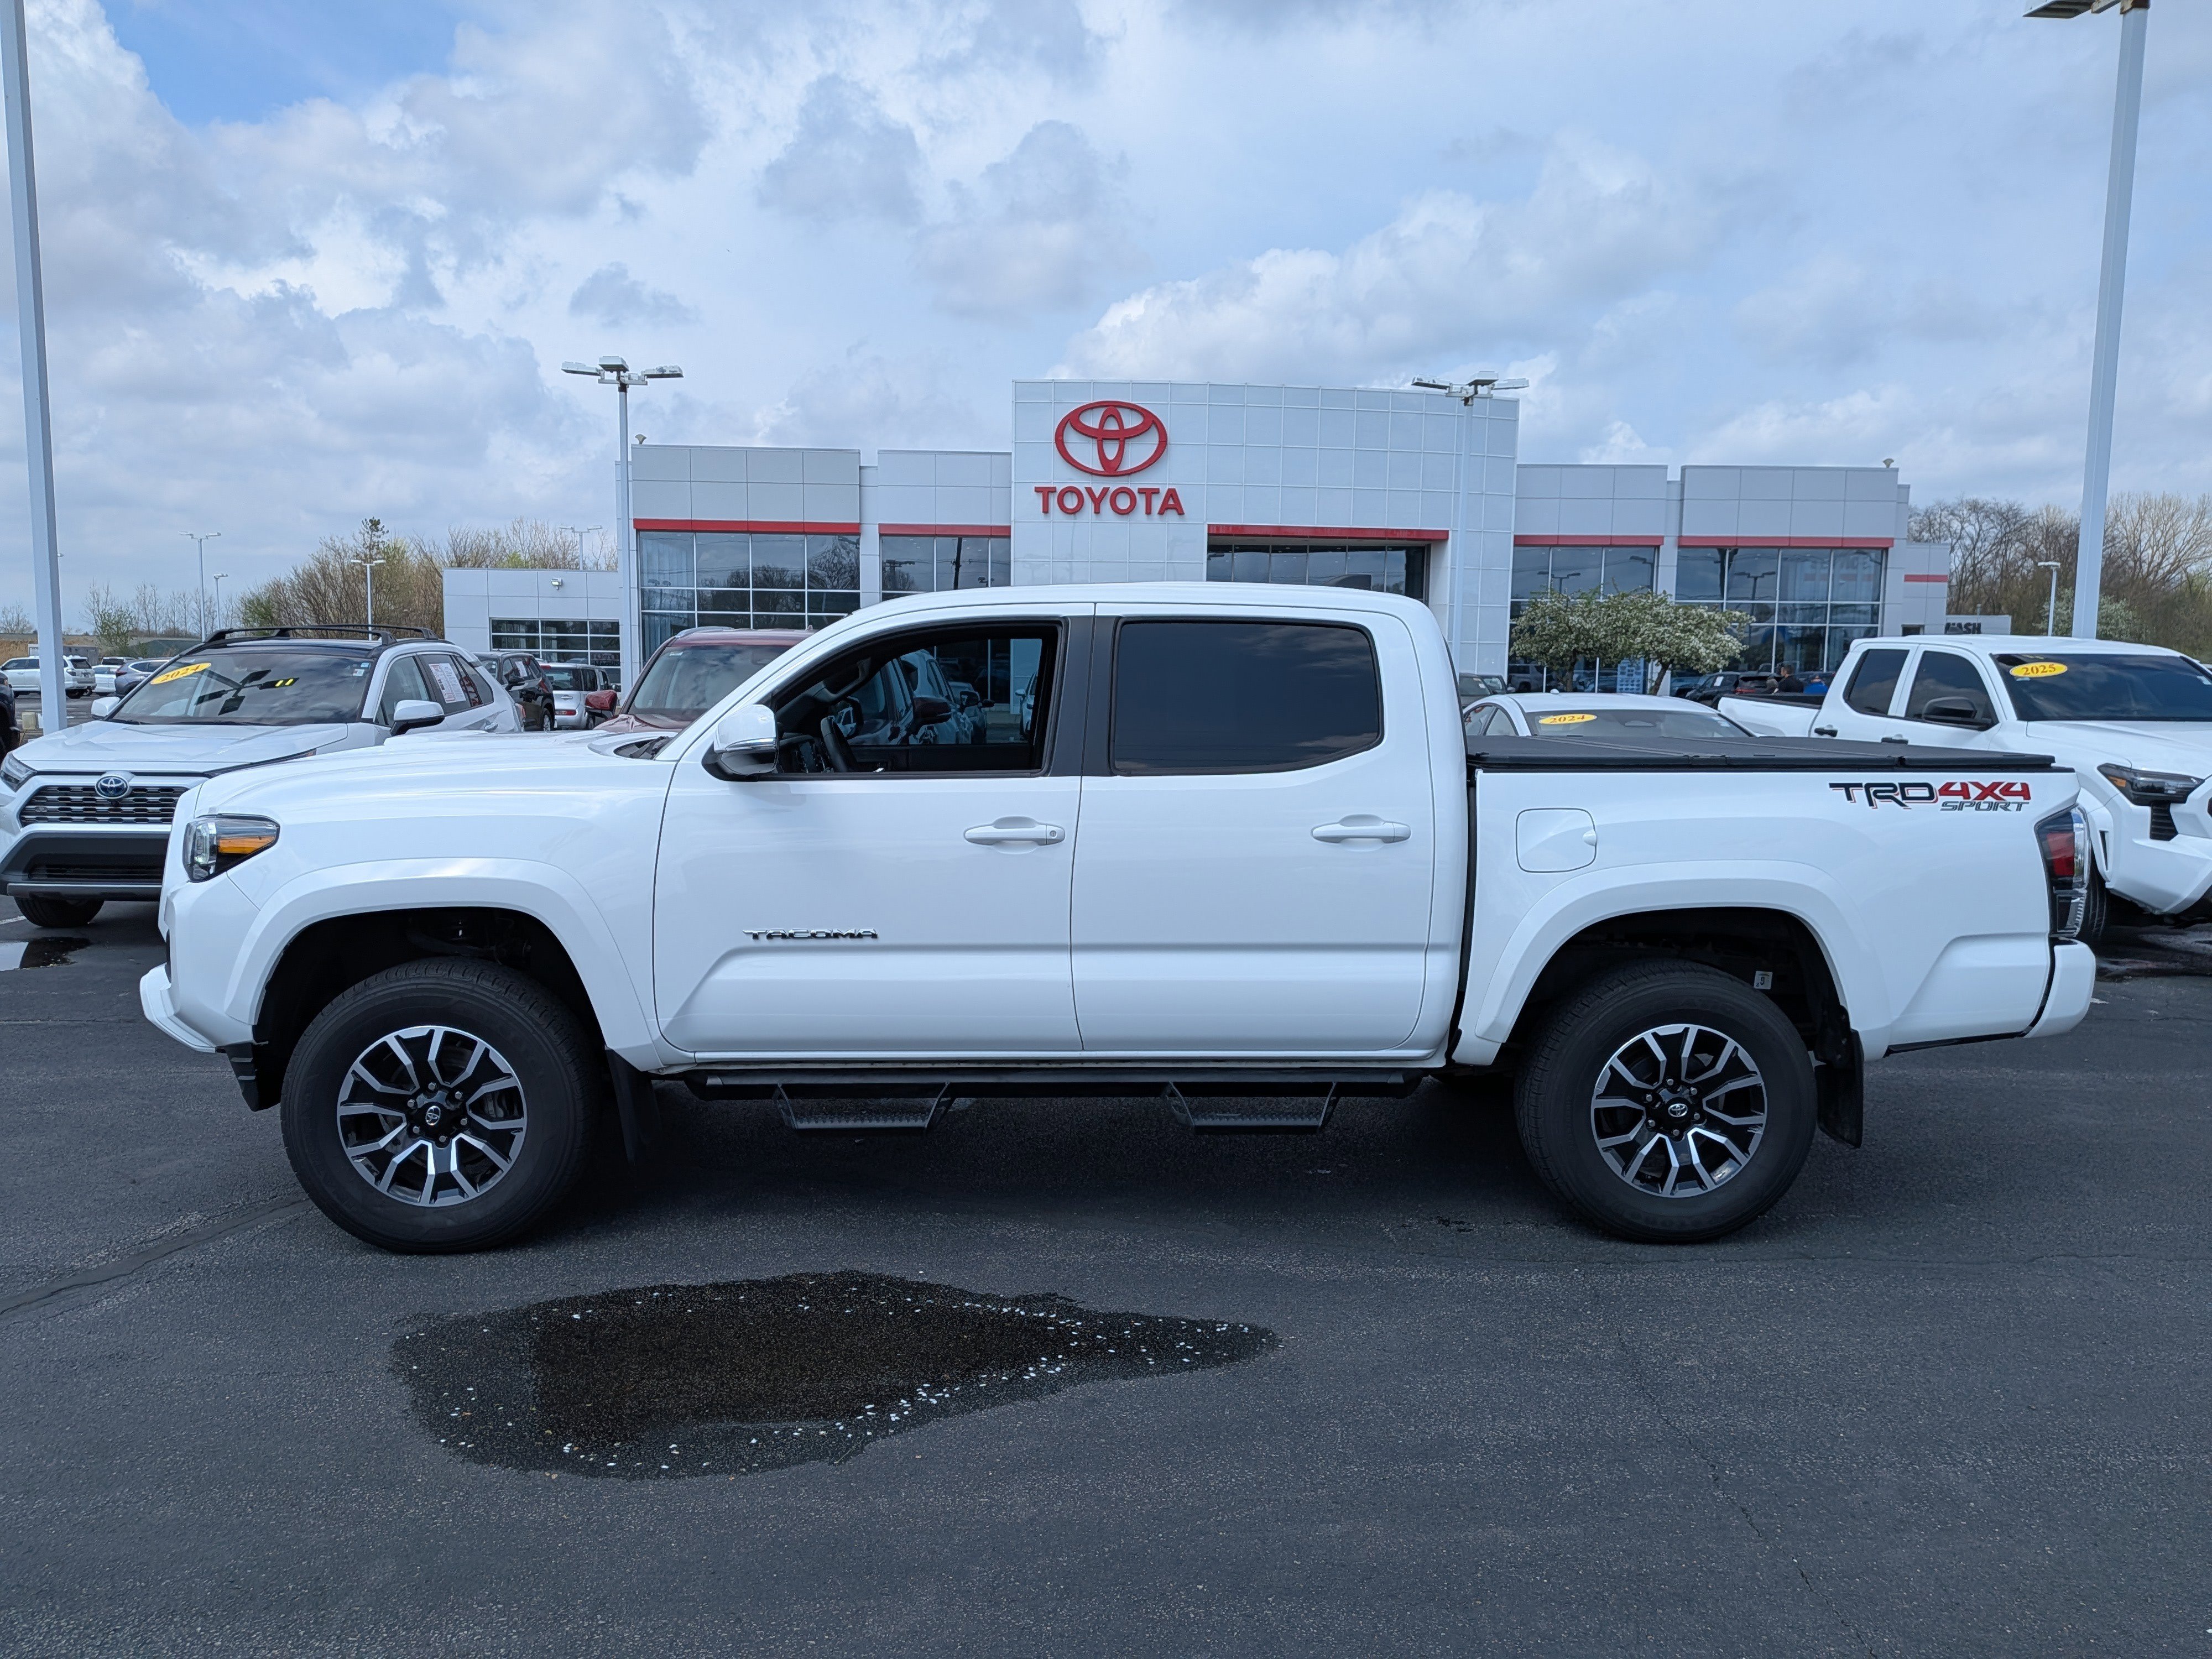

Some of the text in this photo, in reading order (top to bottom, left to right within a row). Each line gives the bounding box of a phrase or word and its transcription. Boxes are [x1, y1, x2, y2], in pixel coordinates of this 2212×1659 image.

[1034, 486, 1185, 515] TOYOTA
[2021, 664, 2056, 676] 2025
[1550, 714, 1585, 723] 2024
[1829, 782, 1938, 810] TRD
[1940, 801, 2030, 812] SPORT
[742, 928, 878, 940] TACOMA
